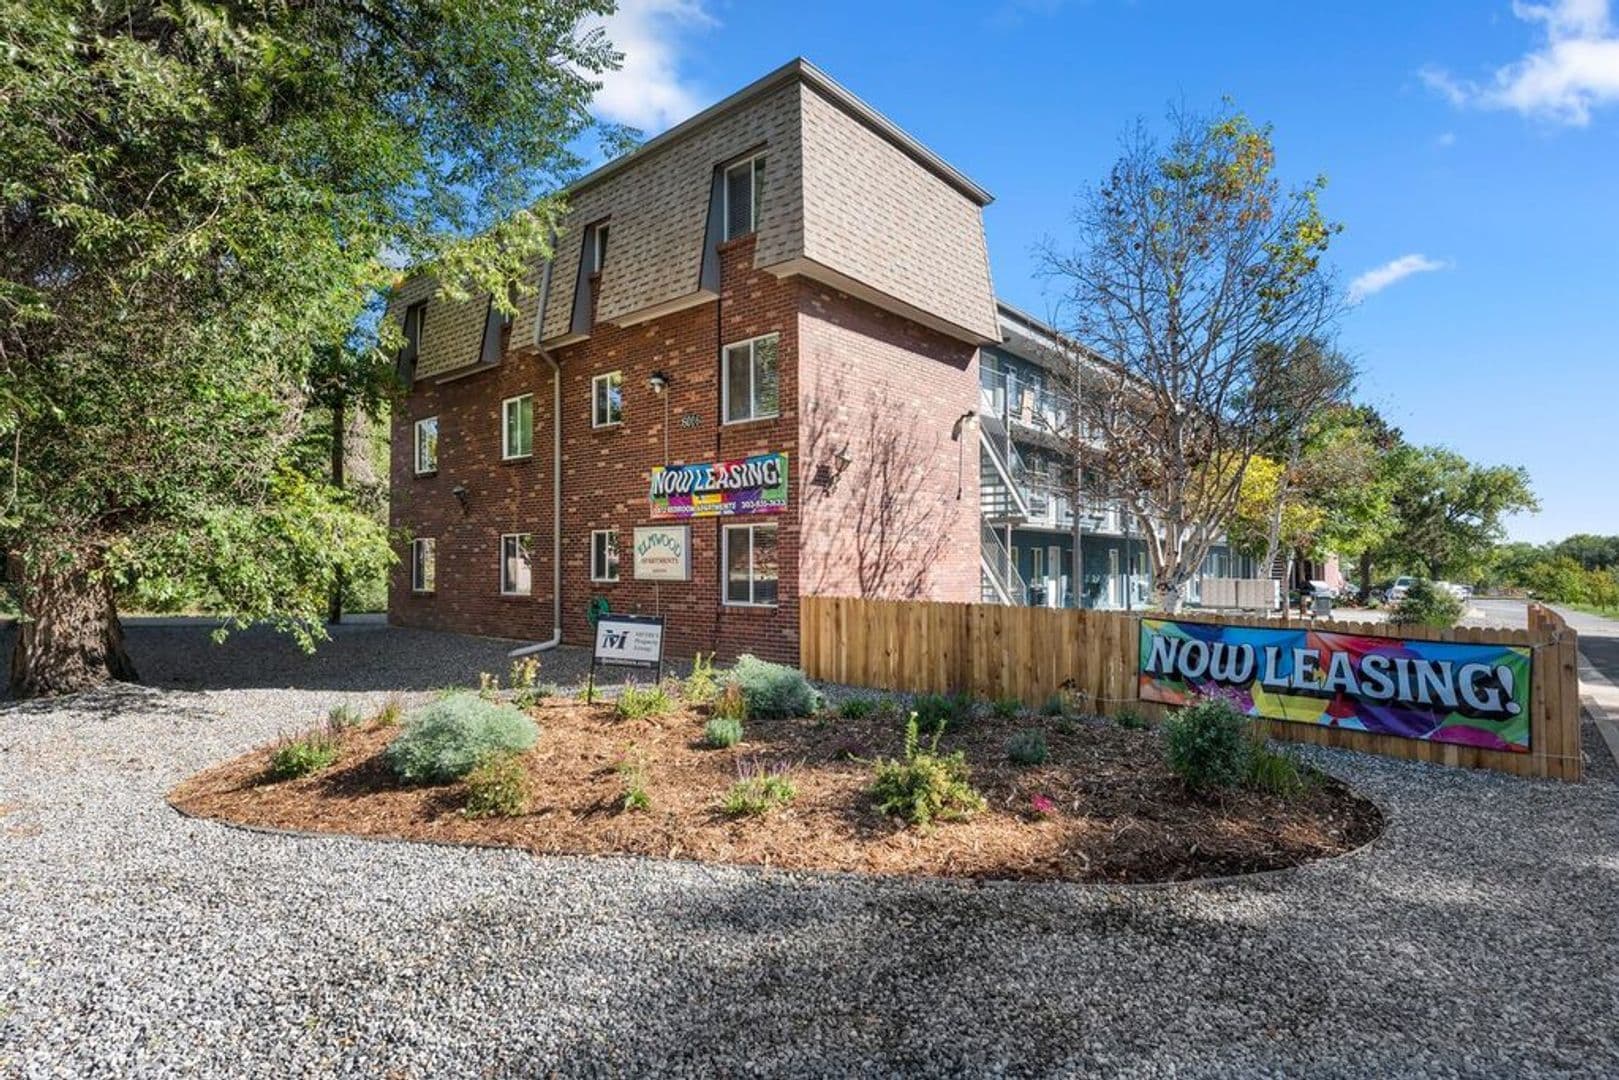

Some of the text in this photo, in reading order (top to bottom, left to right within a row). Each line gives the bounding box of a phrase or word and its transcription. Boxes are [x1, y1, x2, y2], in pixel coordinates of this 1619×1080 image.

[653, 458, 783, 495] NOW LEASING!
[637, 532, 681, 558] ELMWOOD
[1145, 635, 1521, 715] NOW LEASING!
